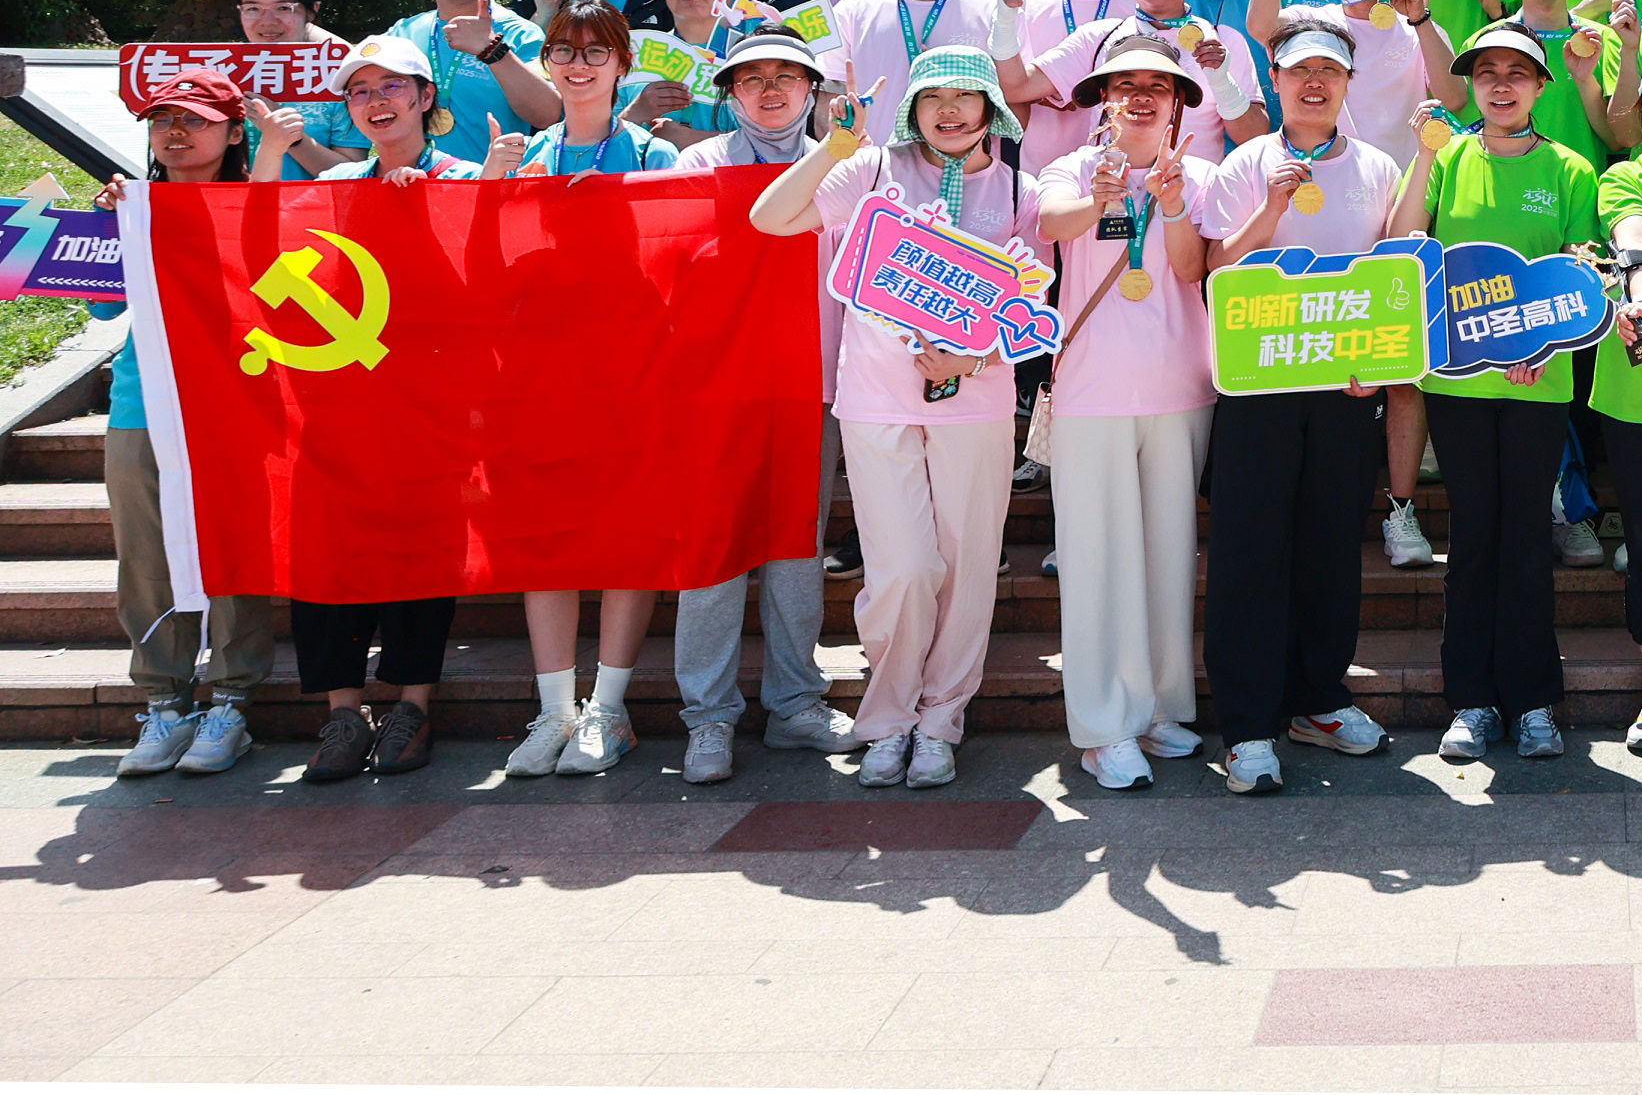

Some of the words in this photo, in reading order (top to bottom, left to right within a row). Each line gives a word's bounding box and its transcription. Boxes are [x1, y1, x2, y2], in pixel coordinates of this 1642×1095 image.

[968, 222, 991, 232] 2025
[1521, 203, 1543, 213] 2025
[52, 235, 121, 264] 加油
[888, 239, 1003, 308] 颜值越高
[1449, 274, 1517, 314] 加油
[871, 264, 980, 334] 责任越大
[1225, 288, 1371, 331] 创新研发
[1456, 290, 1589, 343] 中圣高科
[1258, 326, 1411, 367] 科技中圣
